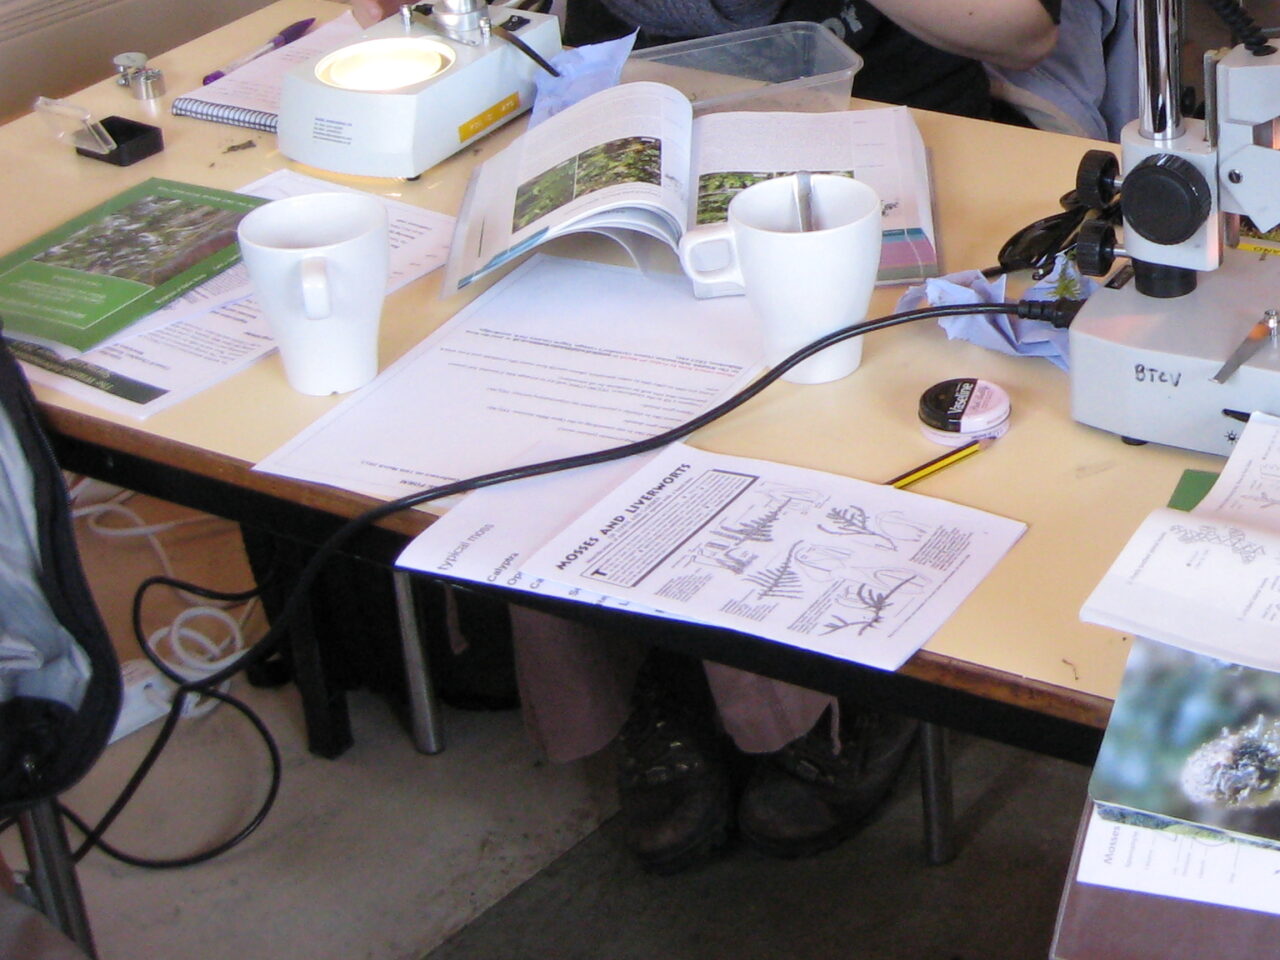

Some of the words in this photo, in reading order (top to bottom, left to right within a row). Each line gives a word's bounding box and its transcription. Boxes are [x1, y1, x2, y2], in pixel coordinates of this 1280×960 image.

[948, 381, 974, 417] Vaseline
[556, 536, 599, 570] MOSSES
[599, 514, 626, 536] AND
[625, 462, 691, 514] LIVERWORTS
[437, 537, 471, 571] typical
[468, 522, 495, 542] moss
[486, 551, 519, 583] Calyptra
[1103, 825, 1120, 865] Mosses
